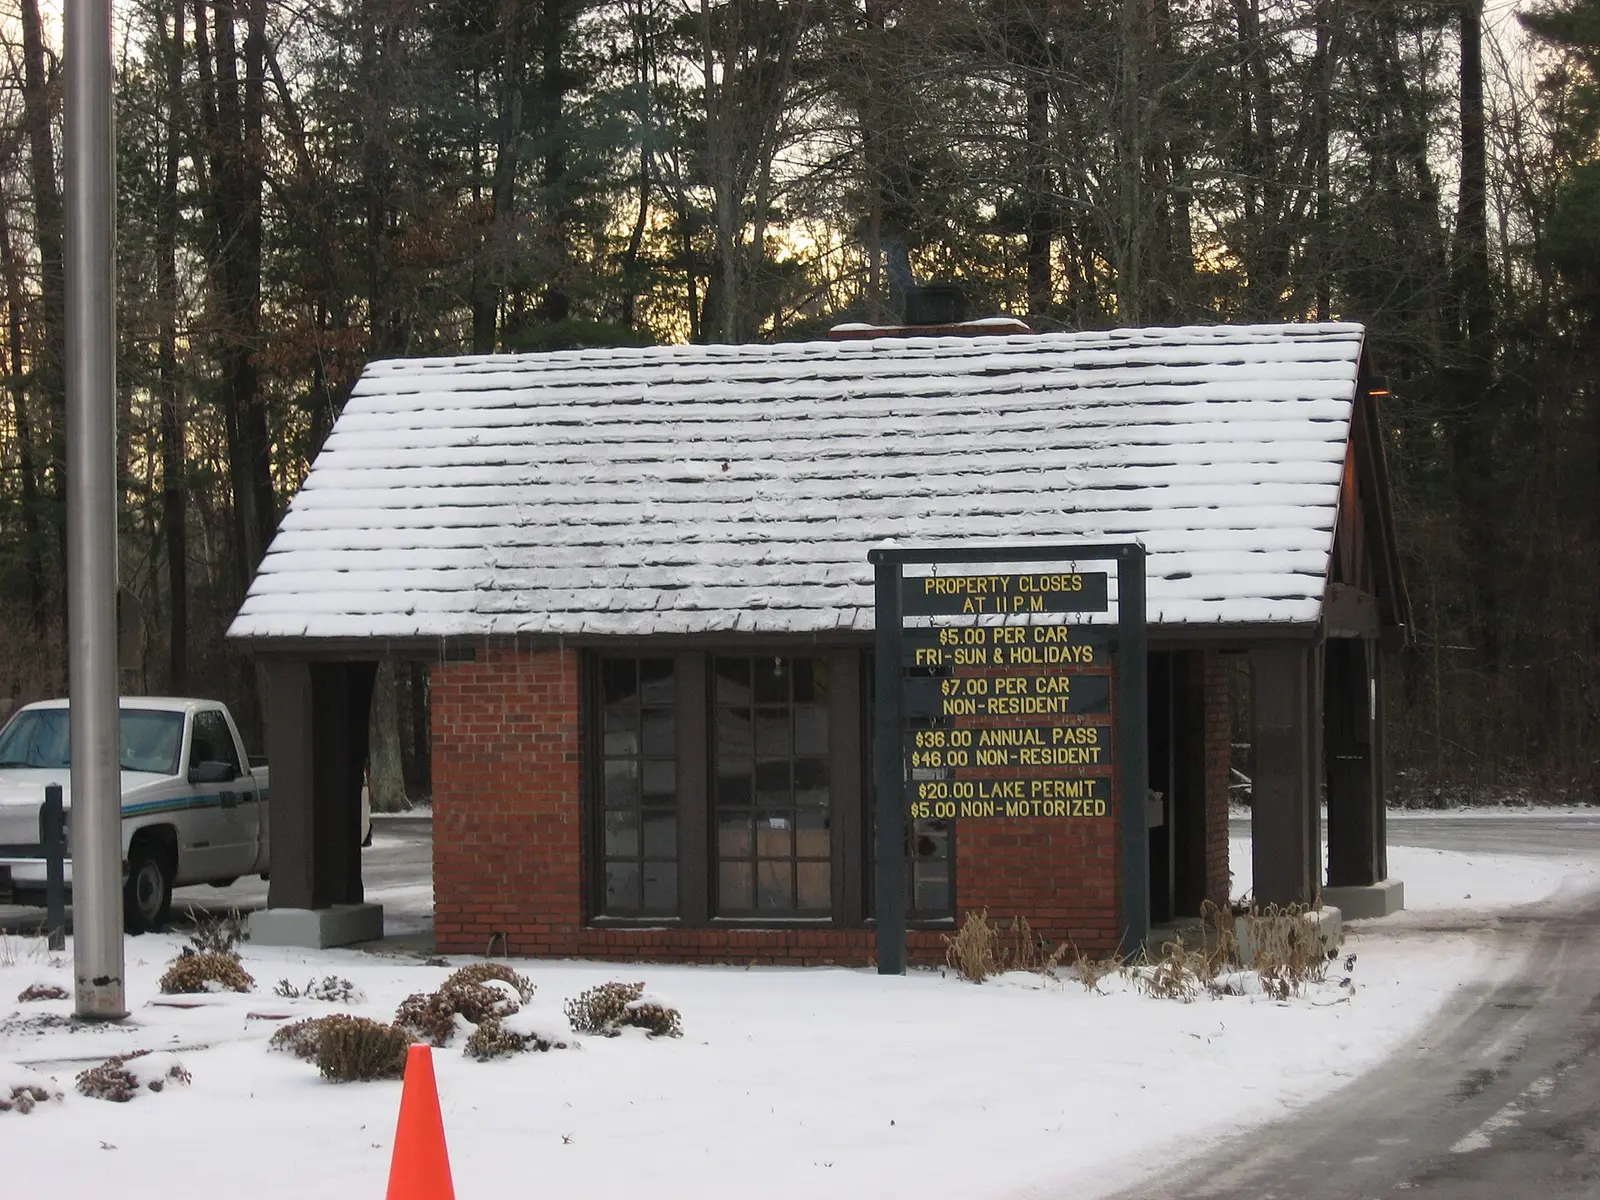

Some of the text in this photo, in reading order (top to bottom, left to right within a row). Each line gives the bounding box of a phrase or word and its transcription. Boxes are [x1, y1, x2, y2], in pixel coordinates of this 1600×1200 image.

[924, 574, 1083, 594] PROPERTY CLOSES
[962, 595, 1048, 613] AT 11 P.M.
[939, 625, 1068, 645] $5.00 PER CAR
[915, 644, 1094, 665] FRI-SUN & HOLIDAYS
[941, 676, 1070, 696] $7.00 PER CAR
[942, 695, 1070, 716] NON-RESIDENT
[915, 727, 1098, 748] $36.00 ANNUAL PASS
[911, 746, 1101, 768] $46.00 NON-RESIDENT
[918, 779, 1096, 800] $20.00 LAKE PERMIT
[910, 798, 1106, 818] $5.00 NON-MOTORIZED
